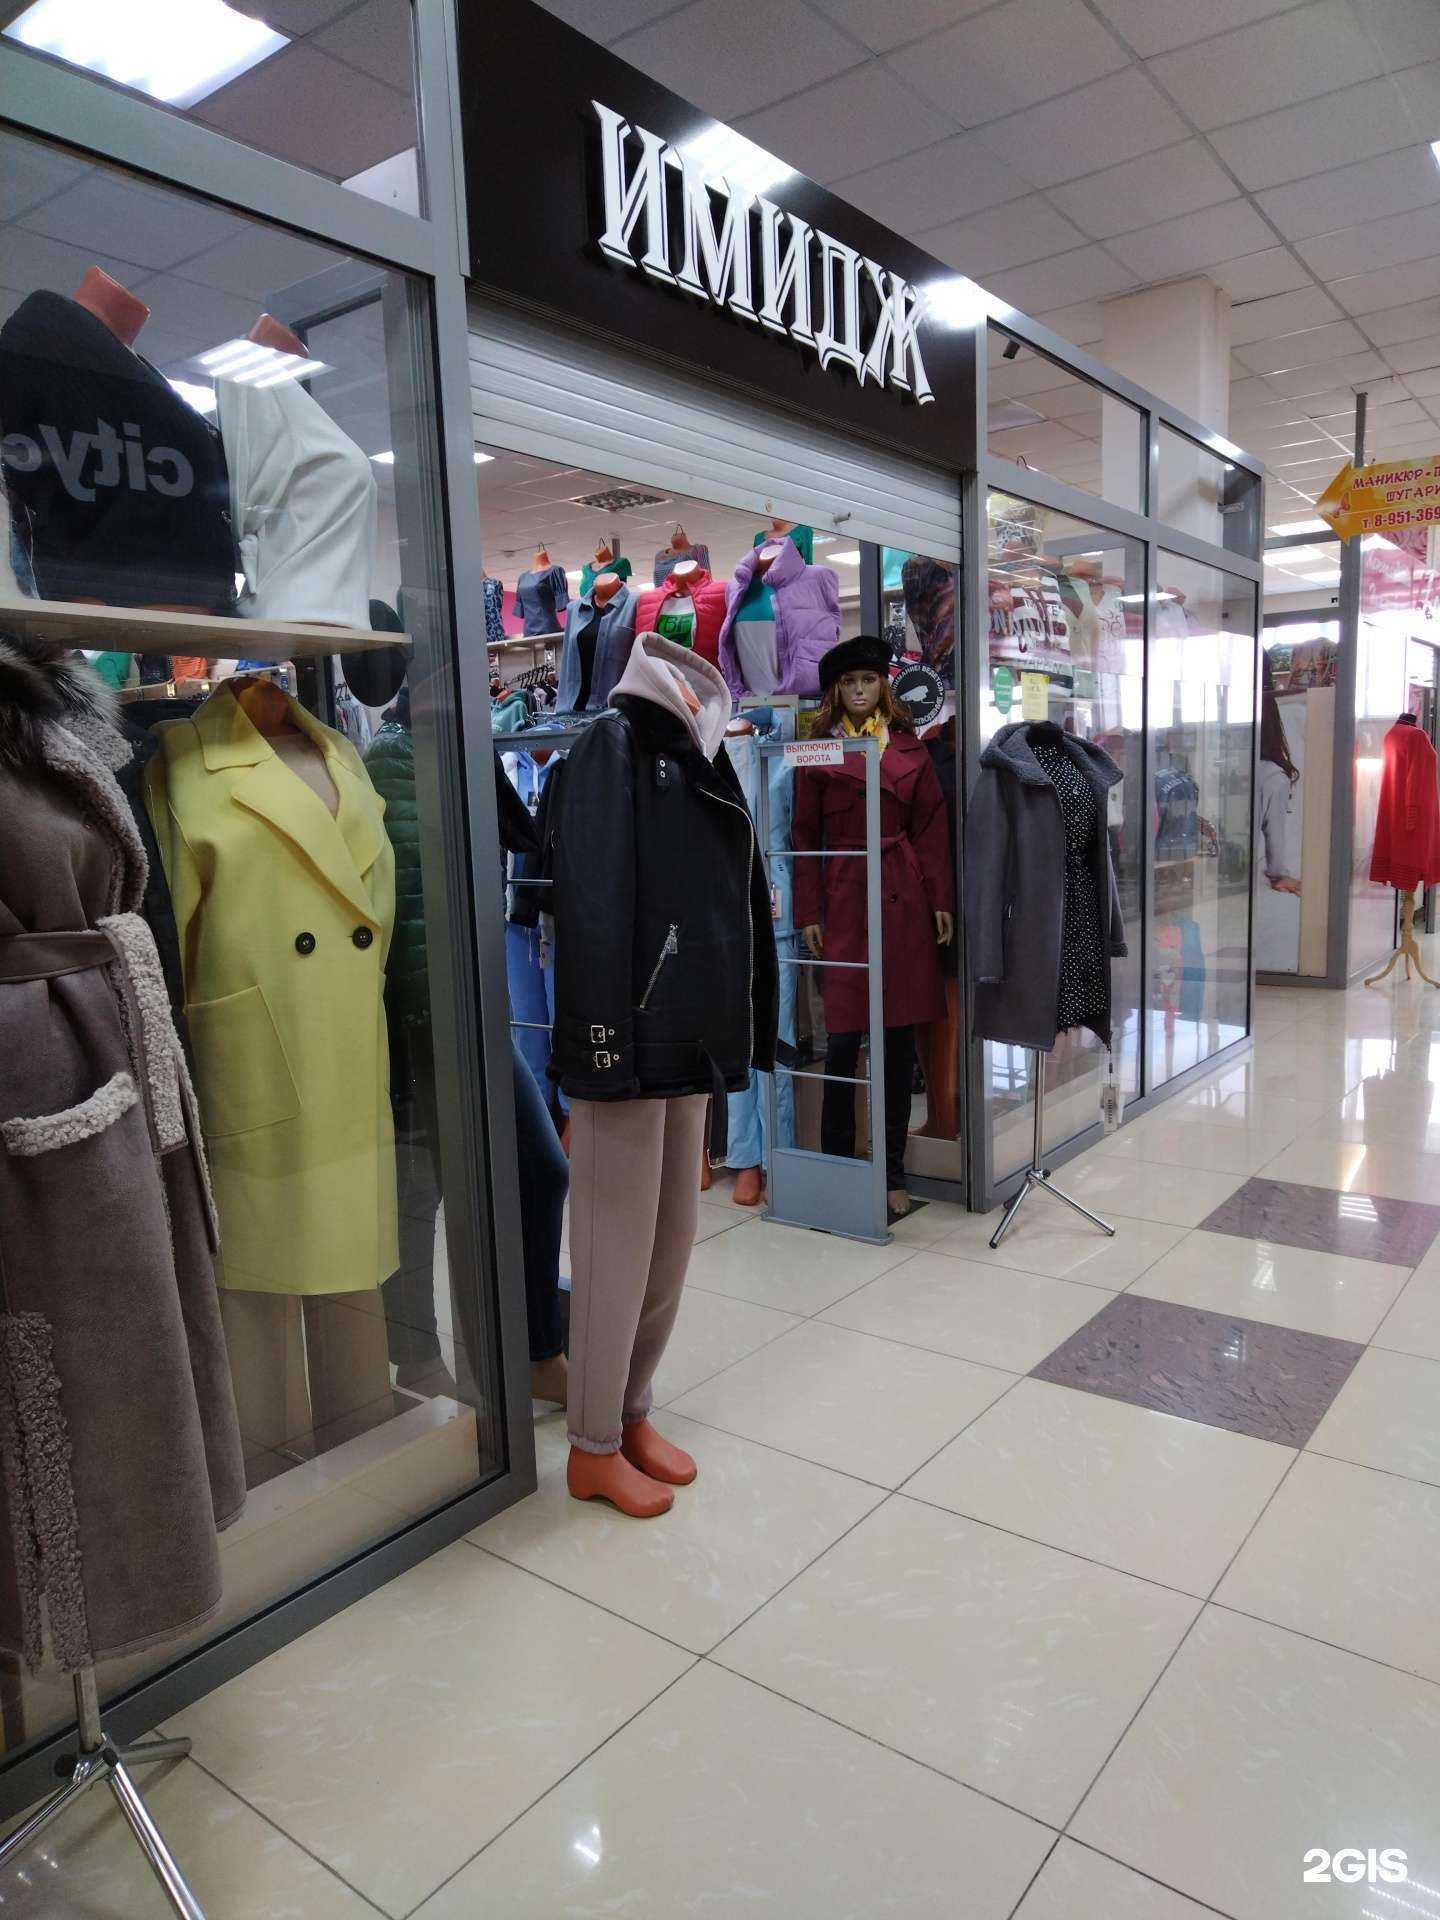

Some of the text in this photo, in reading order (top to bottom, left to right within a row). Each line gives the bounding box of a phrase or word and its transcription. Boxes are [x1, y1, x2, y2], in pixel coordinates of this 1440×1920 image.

[592, 99, 936, 405] ИМИДЖ
[1353, 468, 1424, 490] МАНИКЮР
[786, 742, 841, 753] ВЫКЛЮЧИТЬ
[796, 754, 832, 764] ВОРОТА
